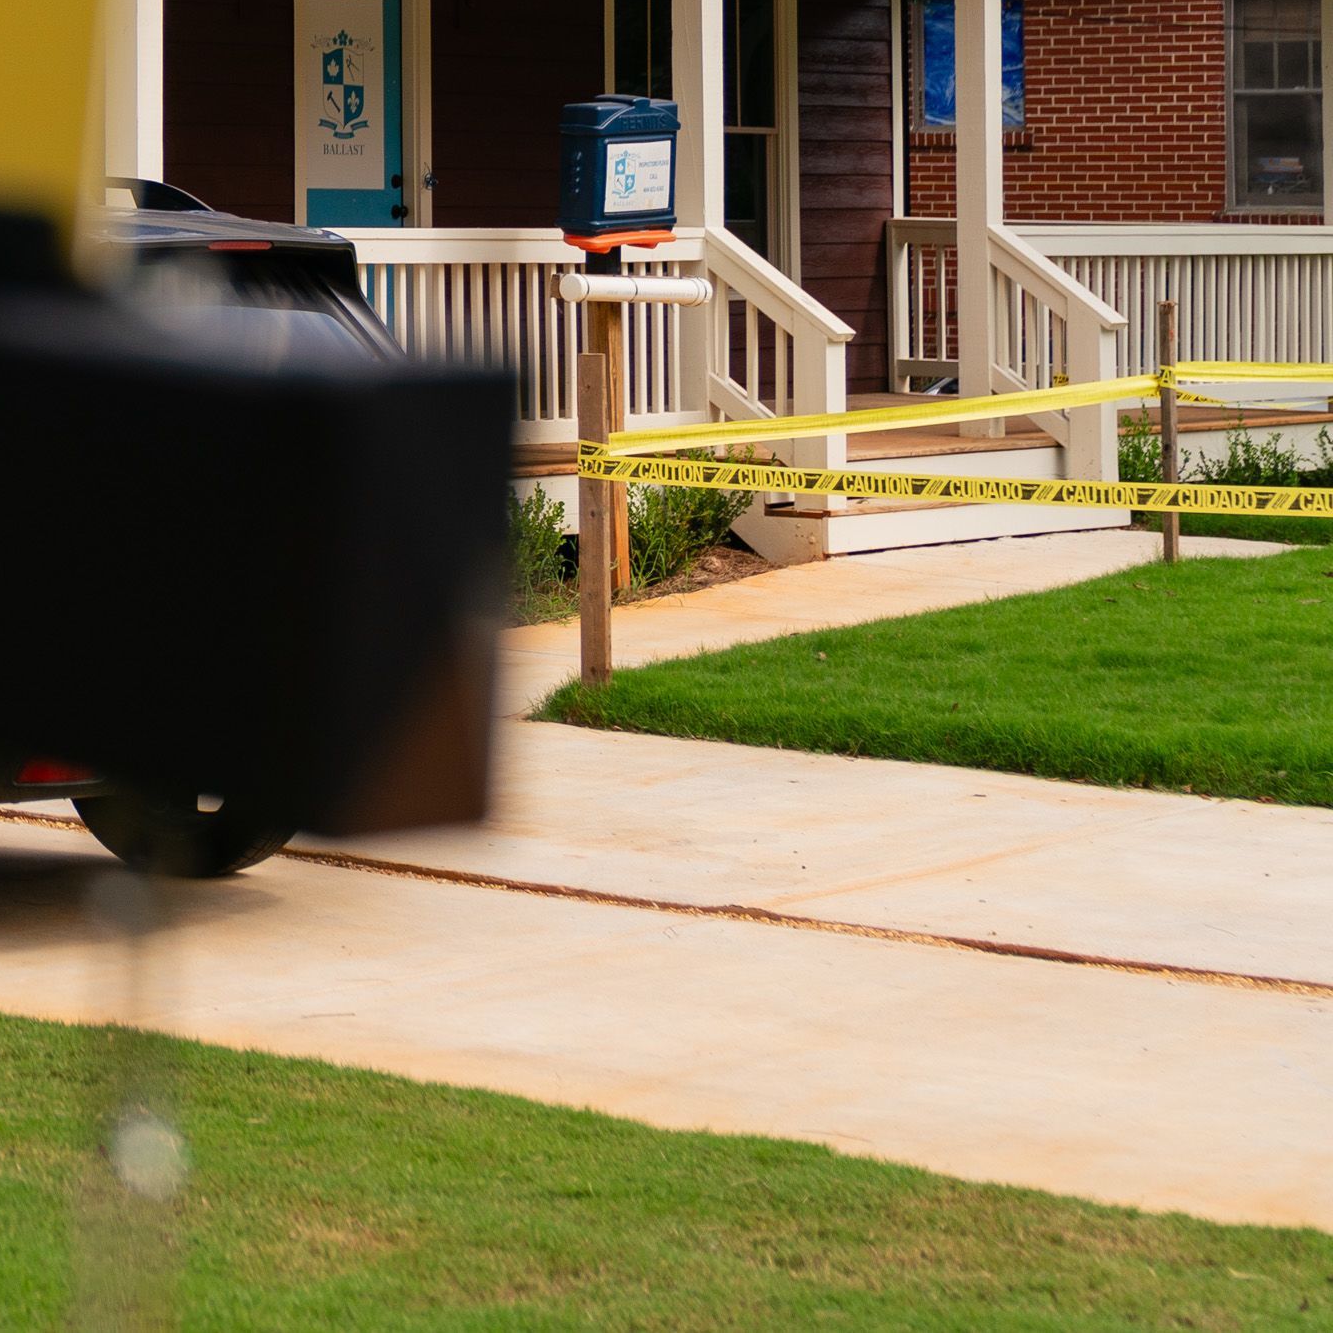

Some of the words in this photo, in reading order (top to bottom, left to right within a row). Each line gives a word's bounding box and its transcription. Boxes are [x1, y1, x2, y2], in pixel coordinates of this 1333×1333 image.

[323, 144, 365, 155] BALLAST
[639, 462, 703, 482] CAUTION
[738, 468, 806, 489] CUIDADO
[842, 474, 913, 495] CAUTION
[949, 479, 1023, 499] CUIDADO
[1062, 485, 1138, 505] CAUTION
[1178, 489, 1257, 509] CUIDADO
[1299, 492, 1333, 511] CAU
